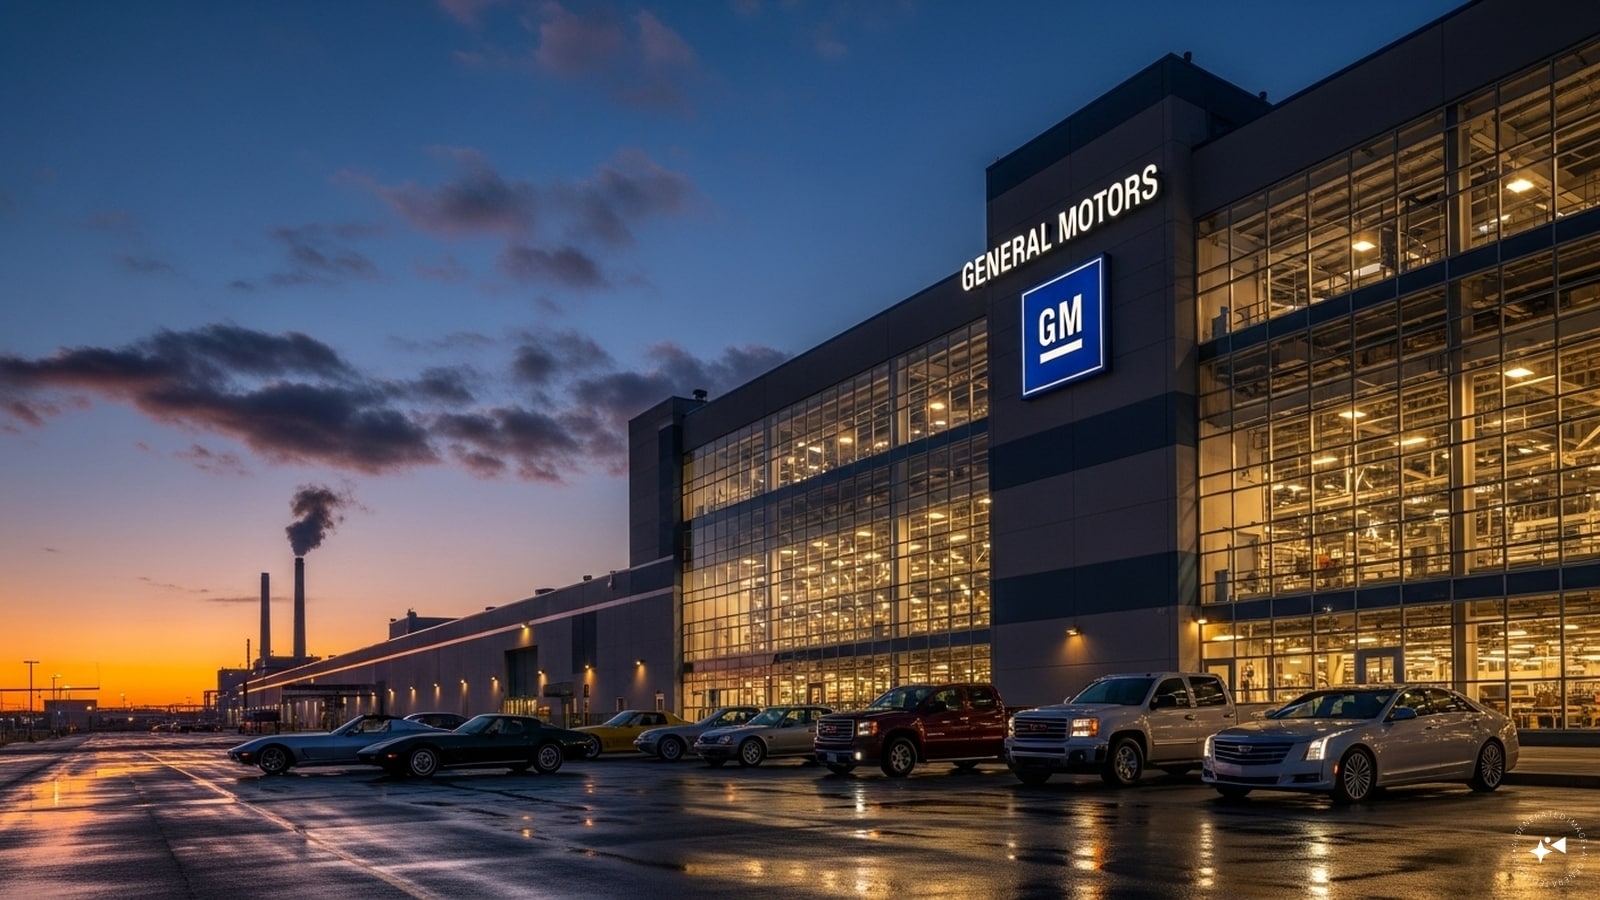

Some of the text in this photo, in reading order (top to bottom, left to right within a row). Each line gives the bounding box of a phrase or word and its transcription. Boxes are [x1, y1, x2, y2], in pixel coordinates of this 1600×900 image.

[962, 163, 1159, 292] GENERAL MOTORS
[1038, 293, 1083, 347] GM
